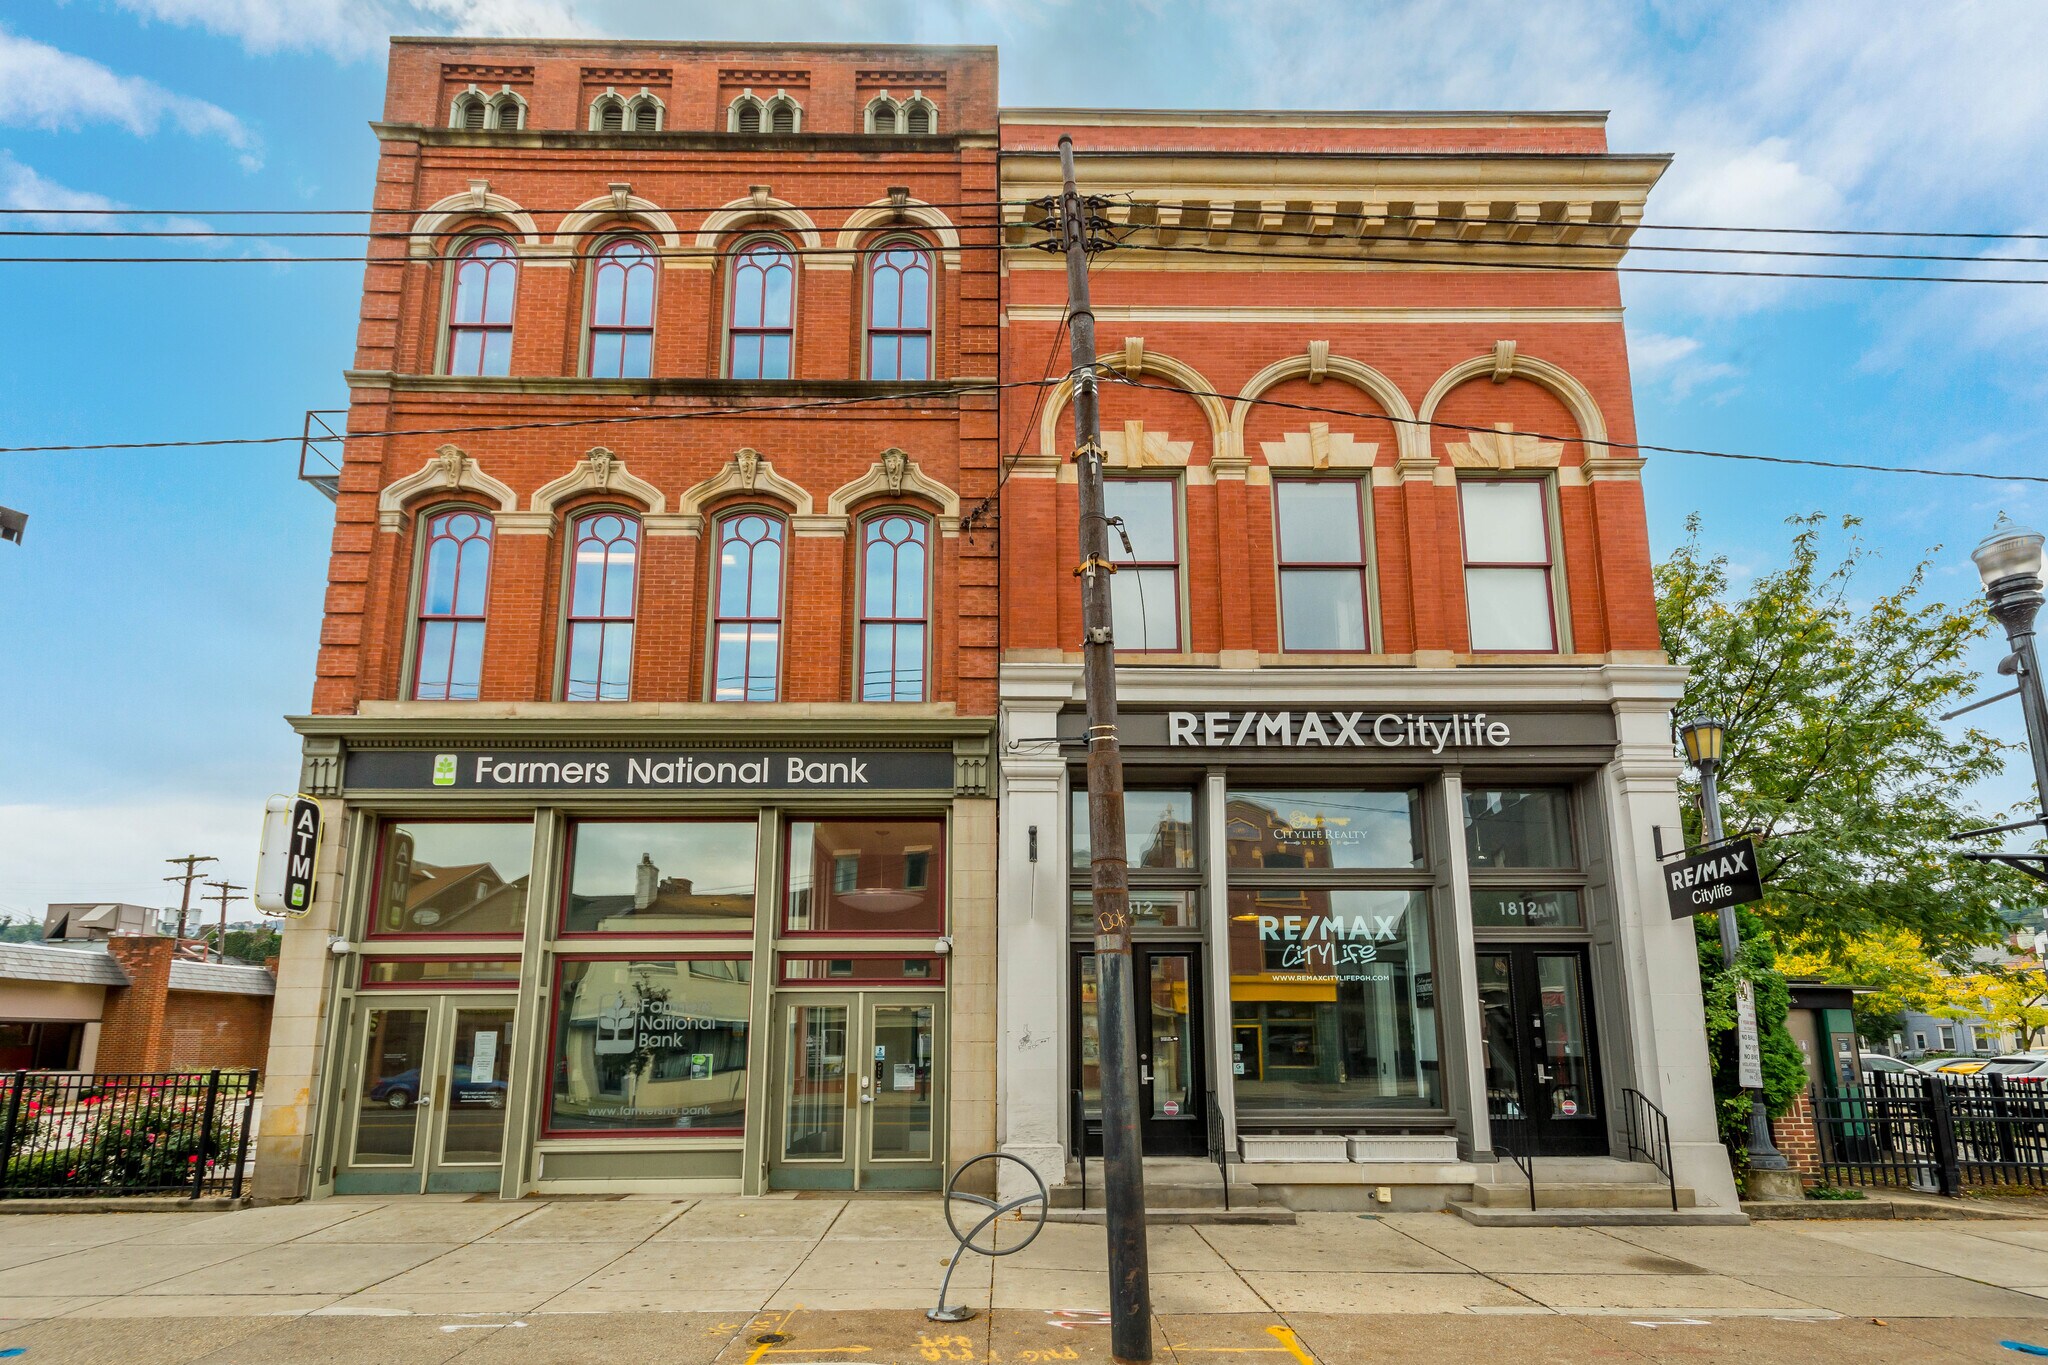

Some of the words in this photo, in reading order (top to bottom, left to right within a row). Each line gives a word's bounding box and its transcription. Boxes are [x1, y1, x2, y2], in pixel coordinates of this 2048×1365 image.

[1168, 711, 1366, 746] RE/MAX
[1373, 713, 1511, 754] Citylife
[475, 756, 610, 784] Farmers
[627, 757, 769, 784] National
[787, 757, 869, 784] Bank
[291, 809, 314, 880] ATM
[1670, 851, 1749, 891] RE/MAX
[1692, 883, 1733, 904] Citylife
[1499, 901, 1537, 916] 1812
[1258, 915, 1397, 941] RE/MAX
[1272, 974, 1390, 982] WWW.REMAXCITYLIFEPGH.COM
[640, 1016, 716, 1030] National
[638, 1032, 683, 1048] Bank
